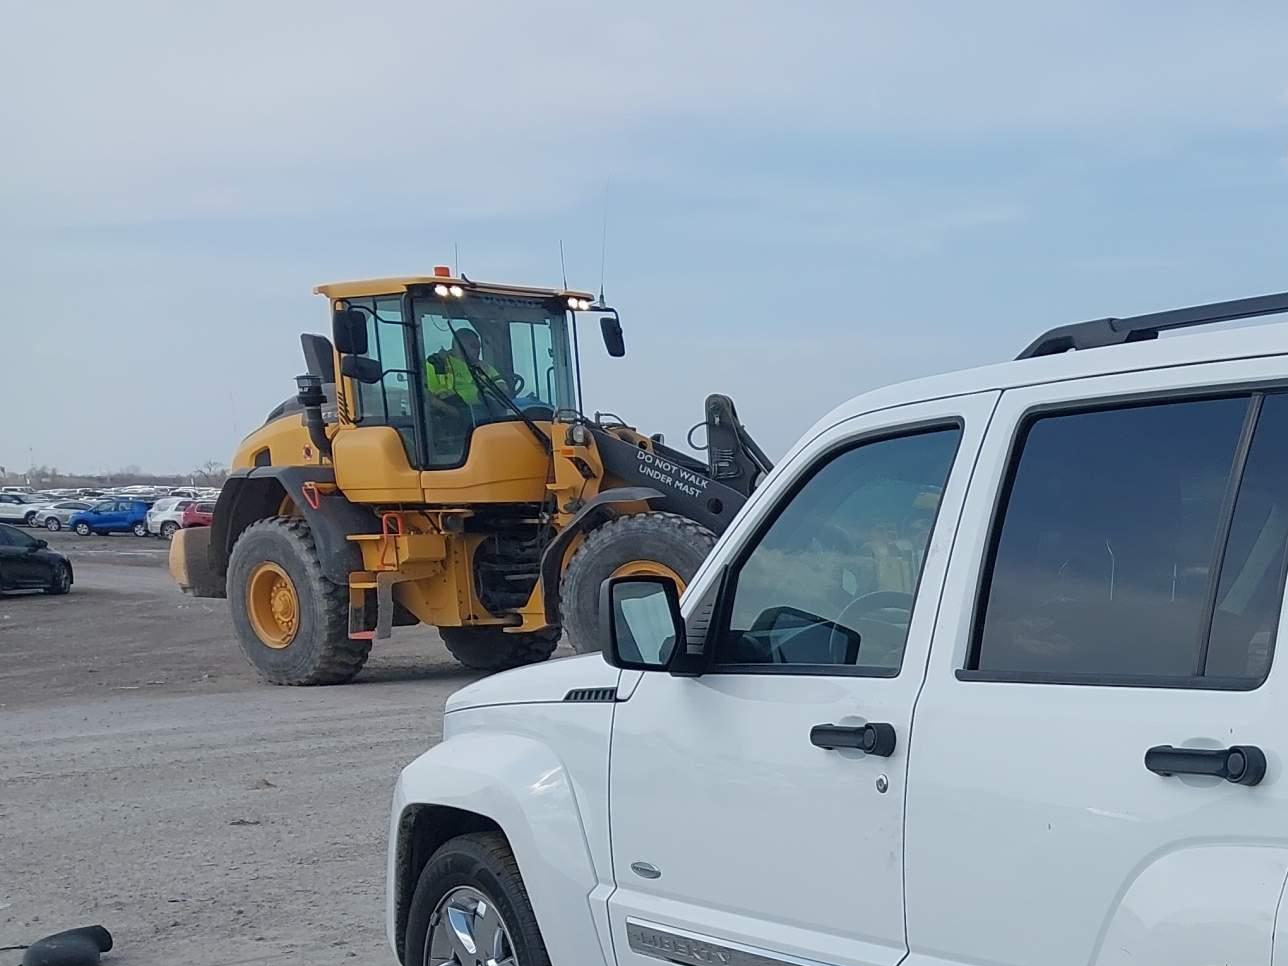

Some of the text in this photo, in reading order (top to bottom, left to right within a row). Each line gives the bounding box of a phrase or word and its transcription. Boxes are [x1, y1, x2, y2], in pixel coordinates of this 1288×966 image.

[637, 450, 708, 488] DO NOT WALK
[639, 464, 701, 498] UNDER MAST
